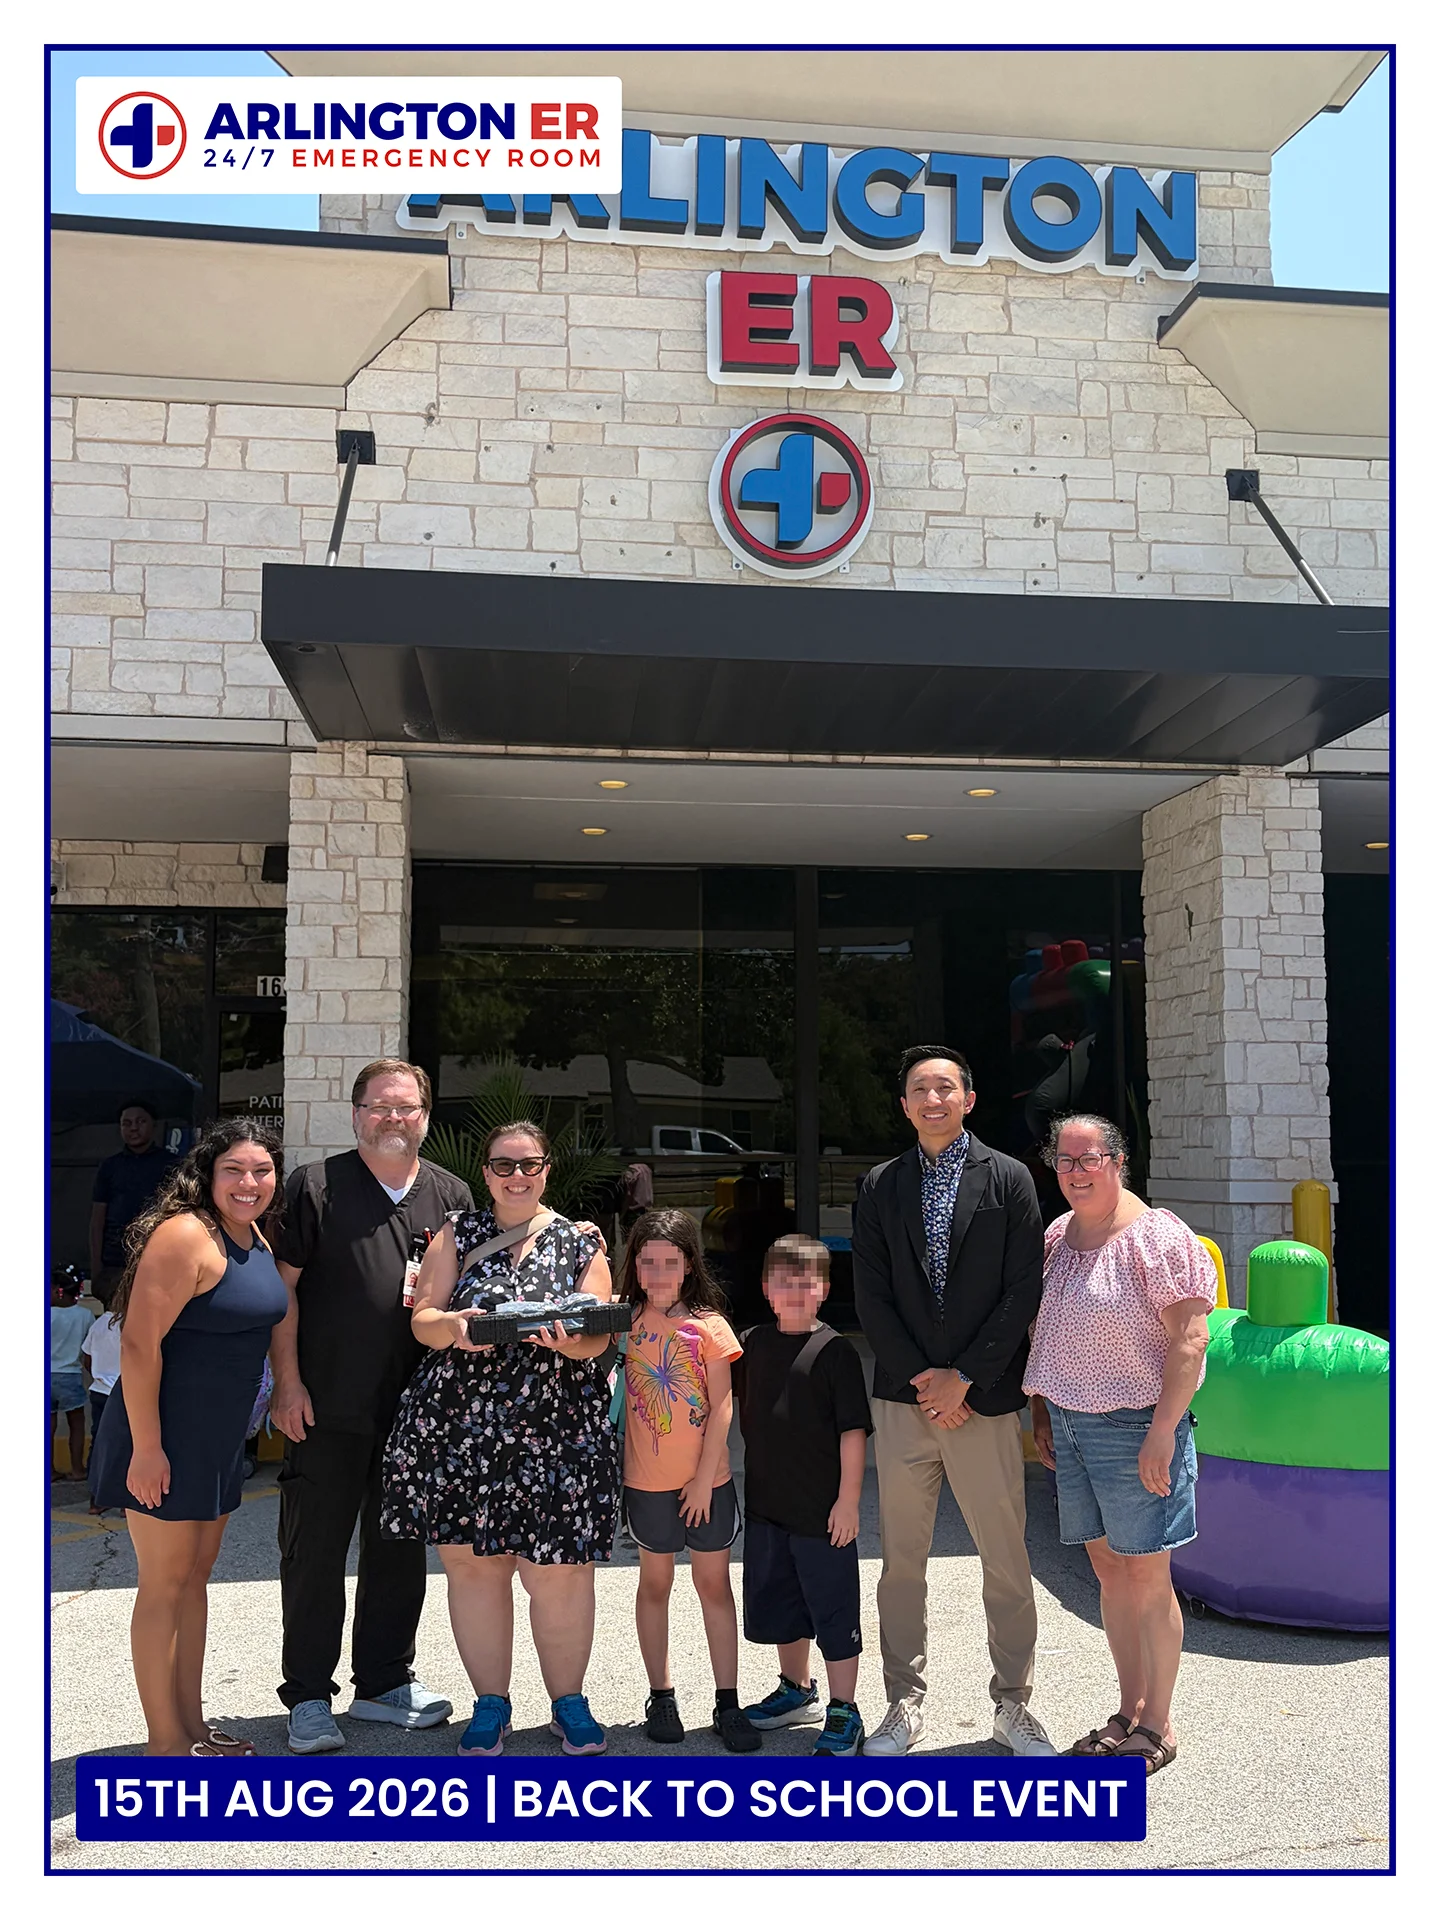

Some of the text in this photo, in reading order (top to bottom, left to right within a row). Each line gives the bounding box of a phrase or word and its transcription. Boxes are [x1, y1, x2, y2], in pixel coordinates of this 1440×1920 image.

[407, 128, 1197, 272] LINGTON
[719, 270, 898, 379] ER
[260, 977, 287, 997] 16
